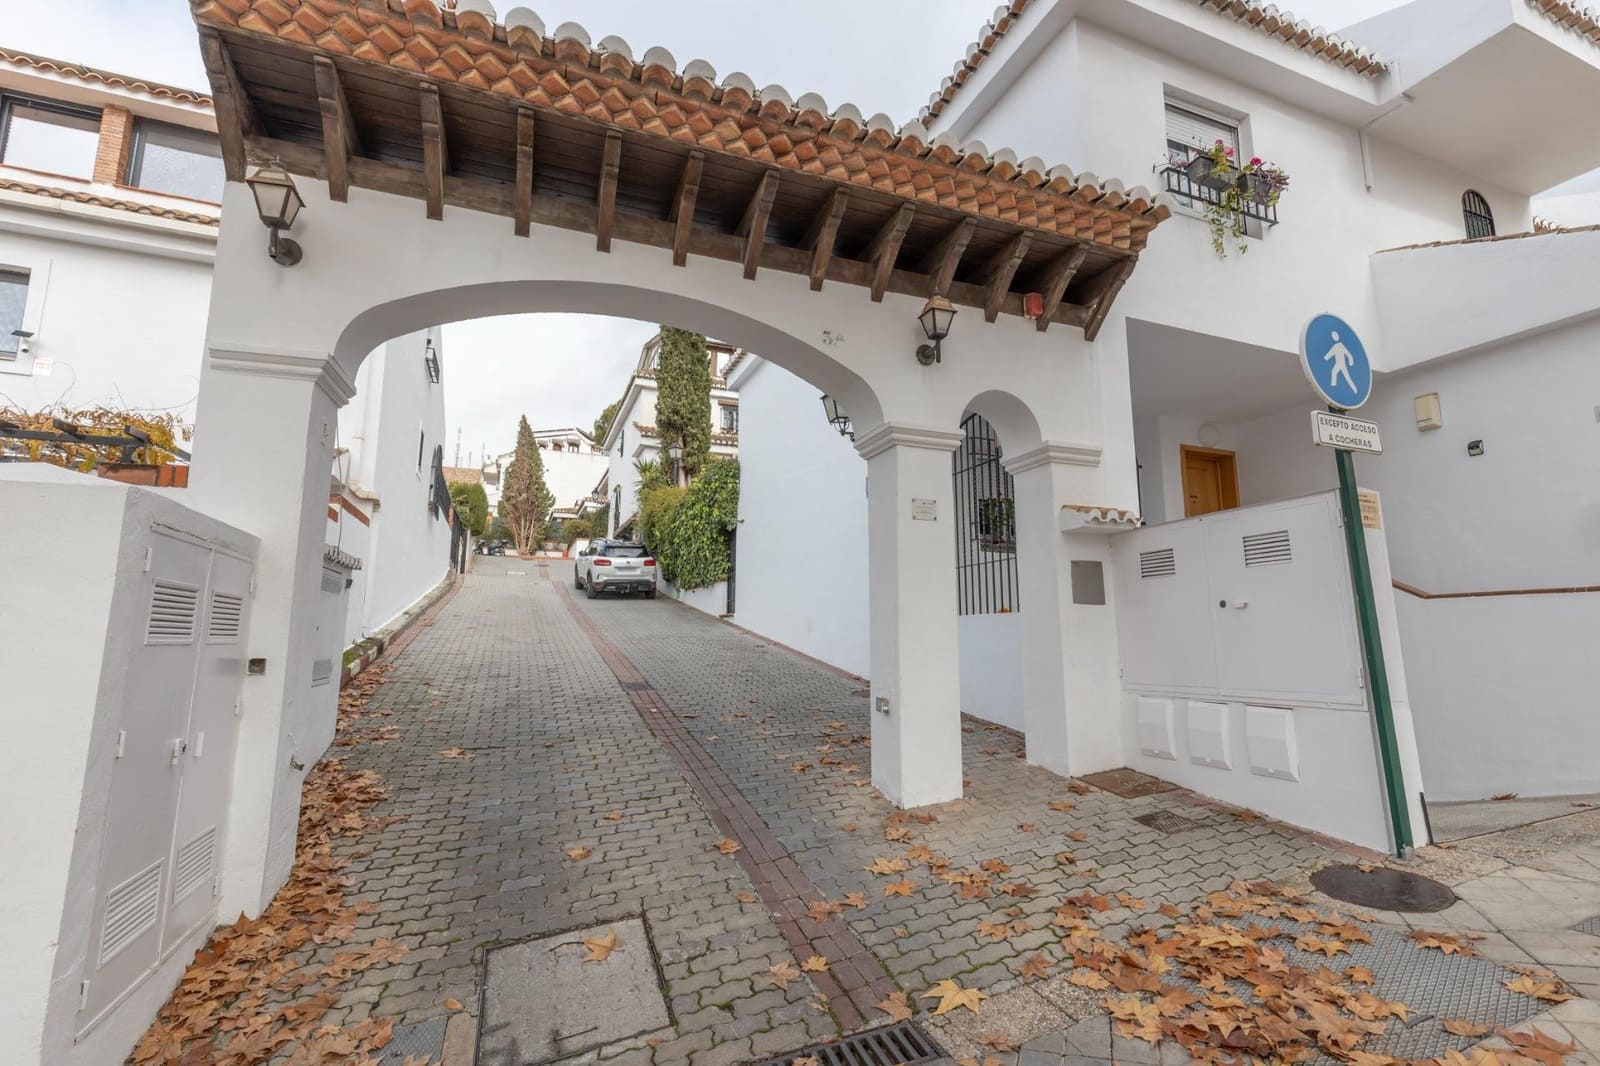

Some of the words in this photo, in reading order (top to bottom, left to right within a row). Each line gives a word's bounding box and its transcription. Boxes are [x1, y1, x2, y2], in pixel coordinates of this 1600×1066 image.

[1320, 417, 1349, 430] EXCEPTO
[1350, 423, 1377, 435] ACCESO
[1328, 433, 1334, 441] A
[1335, 435, 1372, 448] COCHERAS
